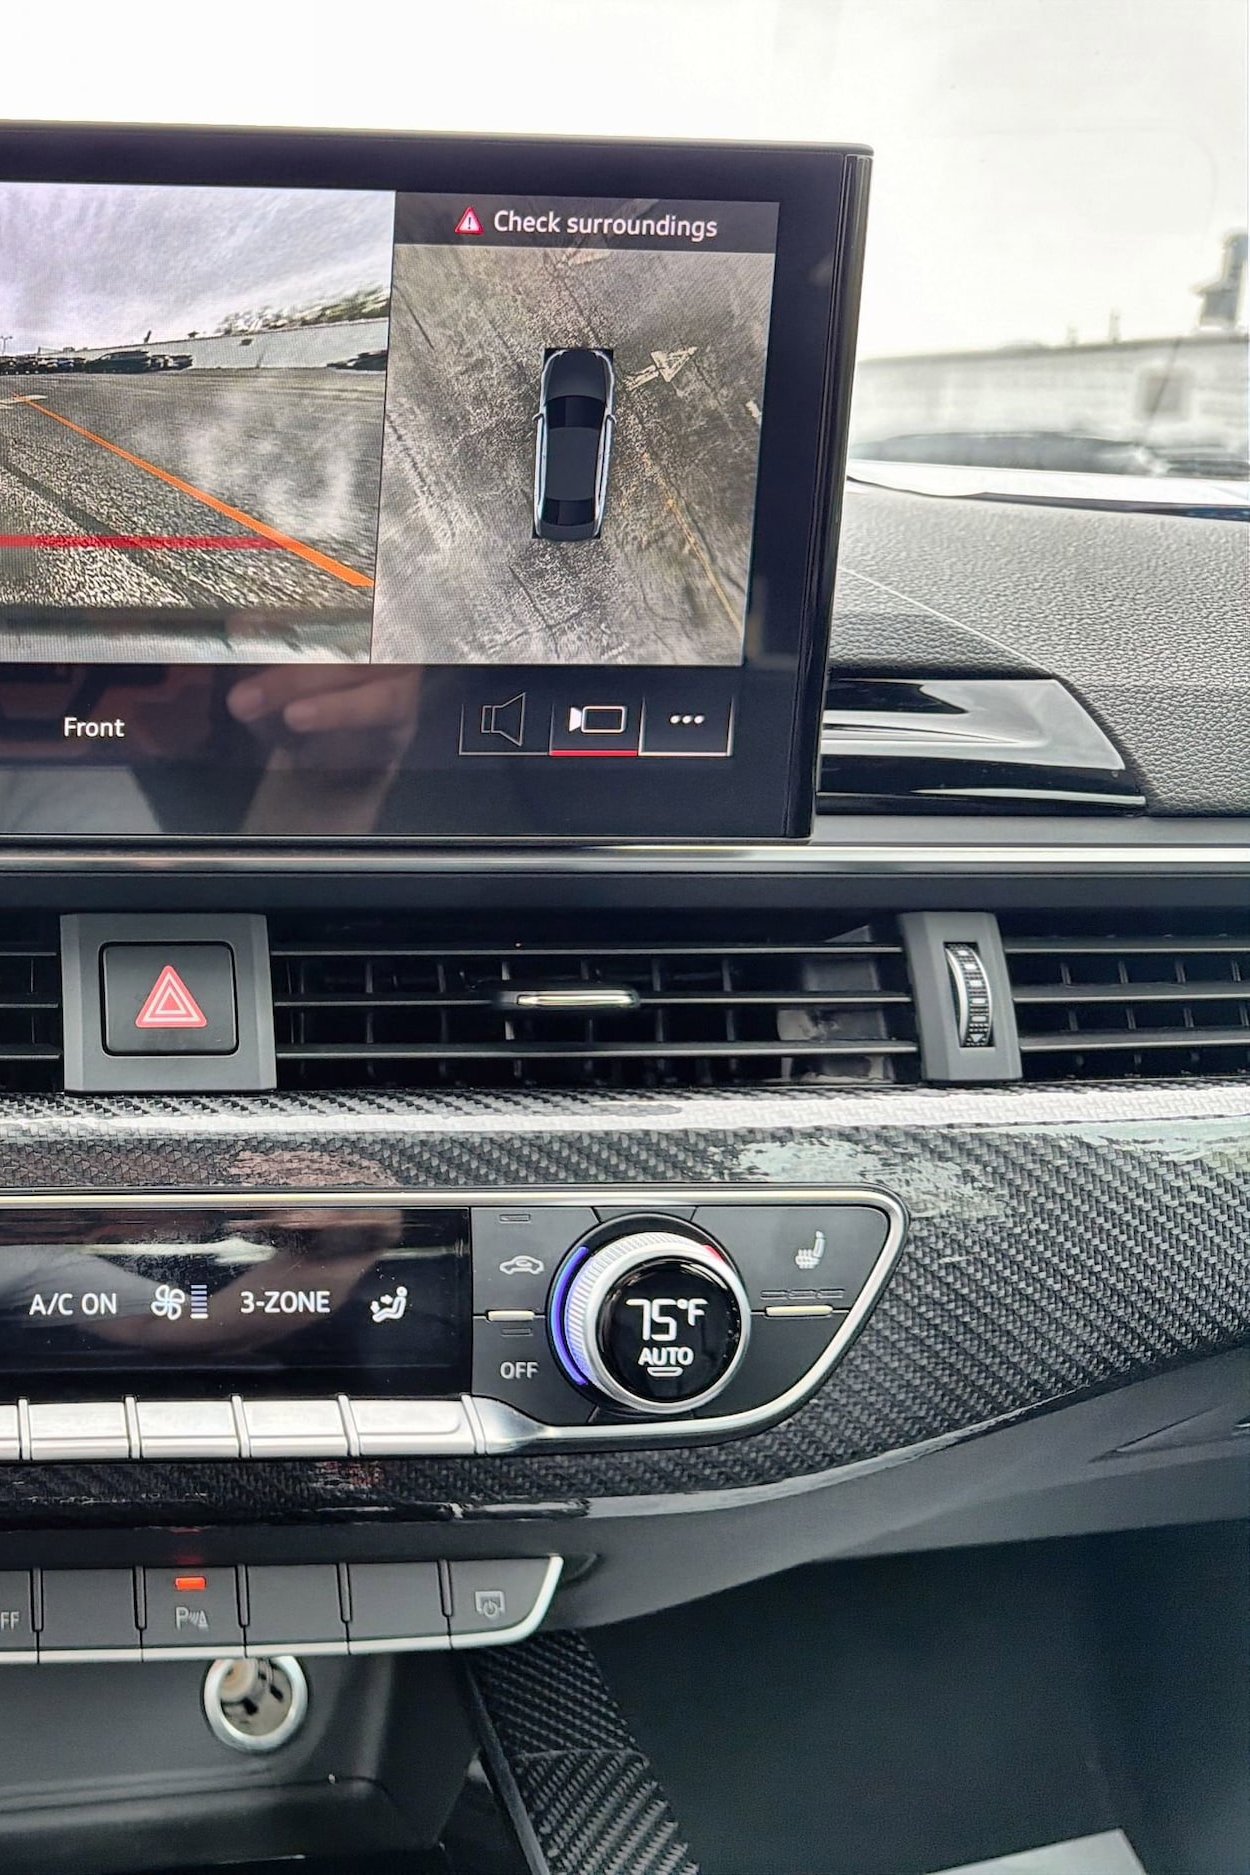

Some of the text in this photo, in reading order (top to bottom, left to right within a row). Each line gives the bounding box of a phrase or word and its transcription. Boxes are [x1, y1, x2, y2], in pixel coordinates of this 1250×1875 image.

[493, 209, 718, 242] Check surroundings
[63, 716, 125, 738] Front
[29, 1293, 118, 1317] A/C ON
[240, 1291, 331, 1314] 3-ZONE
[637, 1347, 694, 1366] AUTO
[499, 1361, 539, 1380] OFF
